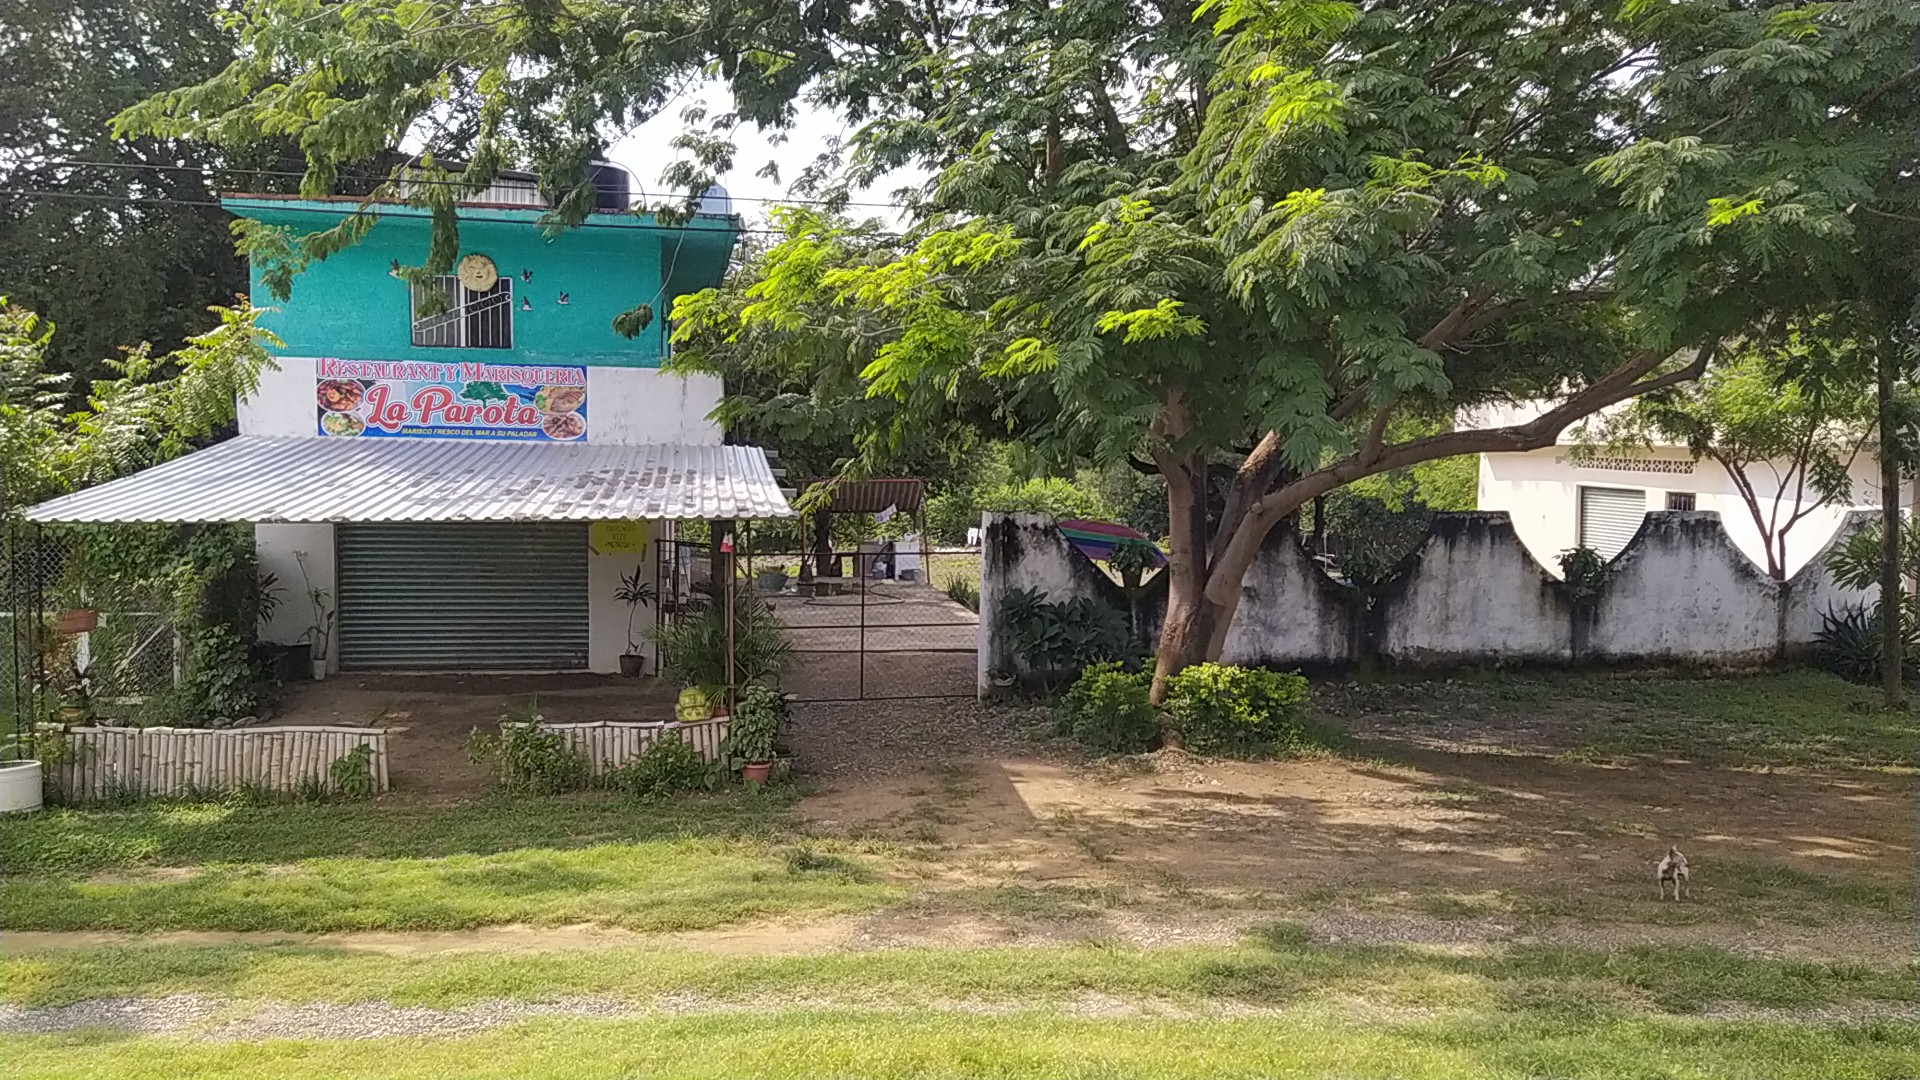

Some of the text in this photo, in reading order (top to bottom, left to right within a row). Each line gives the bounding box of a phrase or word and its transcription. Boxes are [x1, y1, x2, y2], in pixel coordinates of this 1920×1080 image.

[444, 362, 458, 381] Y
[461, 361, 585, 386] MARISQUERIA
[366, 384, 541, 431] La Parota
[432, 428, 461, 436] FRESCO
